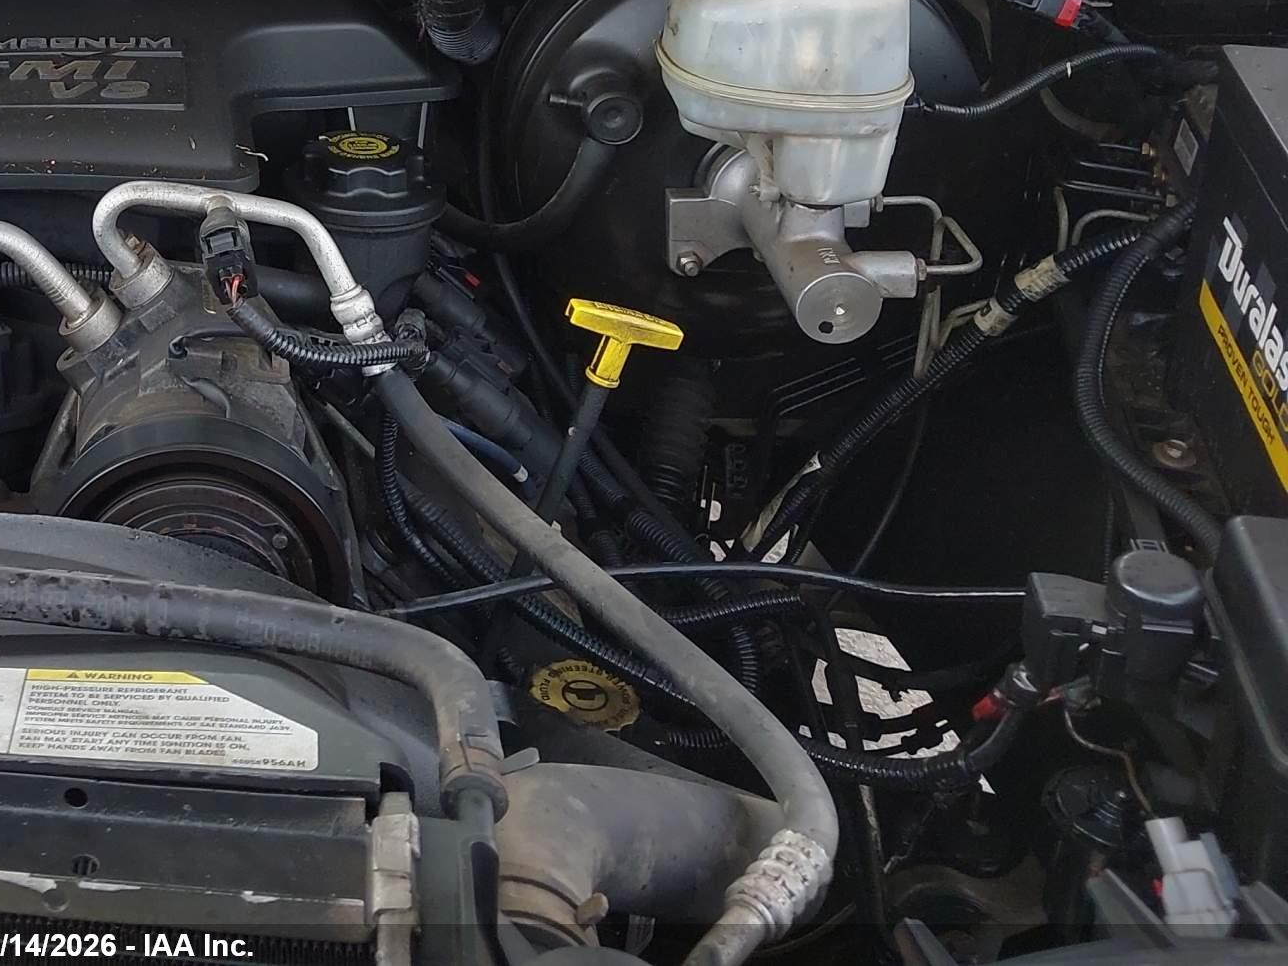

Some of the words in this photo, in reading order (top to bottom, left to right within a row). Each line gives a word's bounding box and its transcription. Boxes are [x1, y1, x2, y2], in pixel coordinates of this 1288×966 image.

[1218, 216, 1288, 392] Duralas
[1216, 325, 1248, 384] PROVEN
[1247, 385, 1276, 445] TOUGH
[84, 672, 153, 681] WARNING
[538, 677, 552, 702] FLUID
